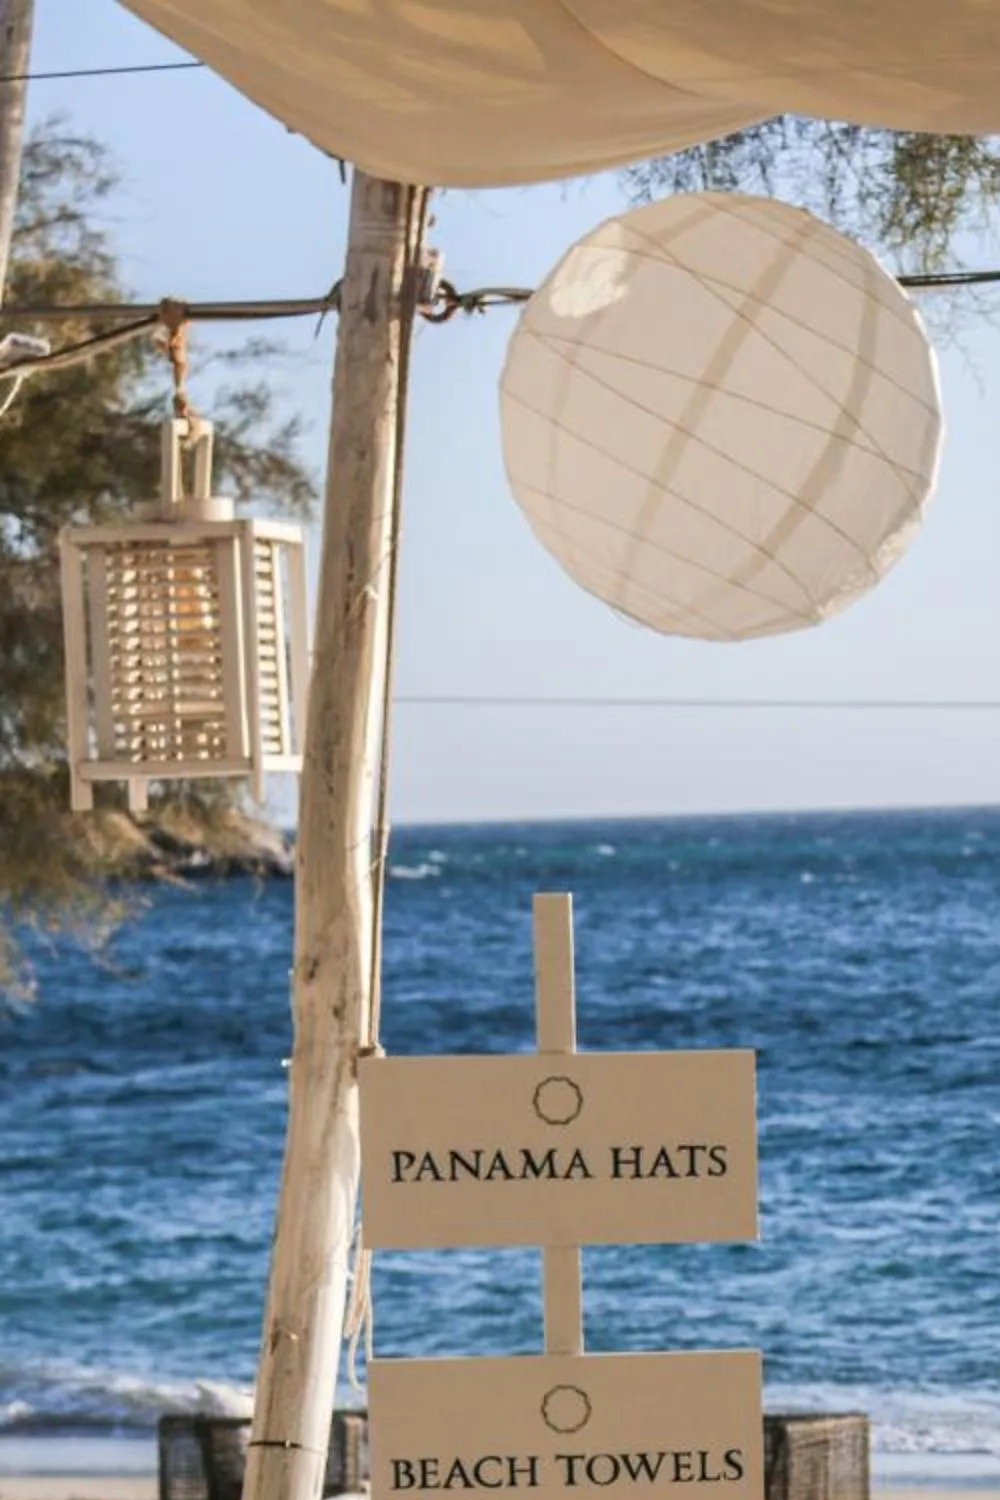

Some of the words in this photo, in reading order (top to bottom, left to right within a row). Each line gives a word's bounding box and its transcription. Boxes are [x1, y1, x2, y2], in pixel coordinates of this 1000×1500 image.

[391, 1148, 594, 1183] PANAMA
[610, 1145, 728, 1179] HATS
[390, 1456, 539, 1491] BEACH
[556, 1449, 744, 1486] TOWELS
